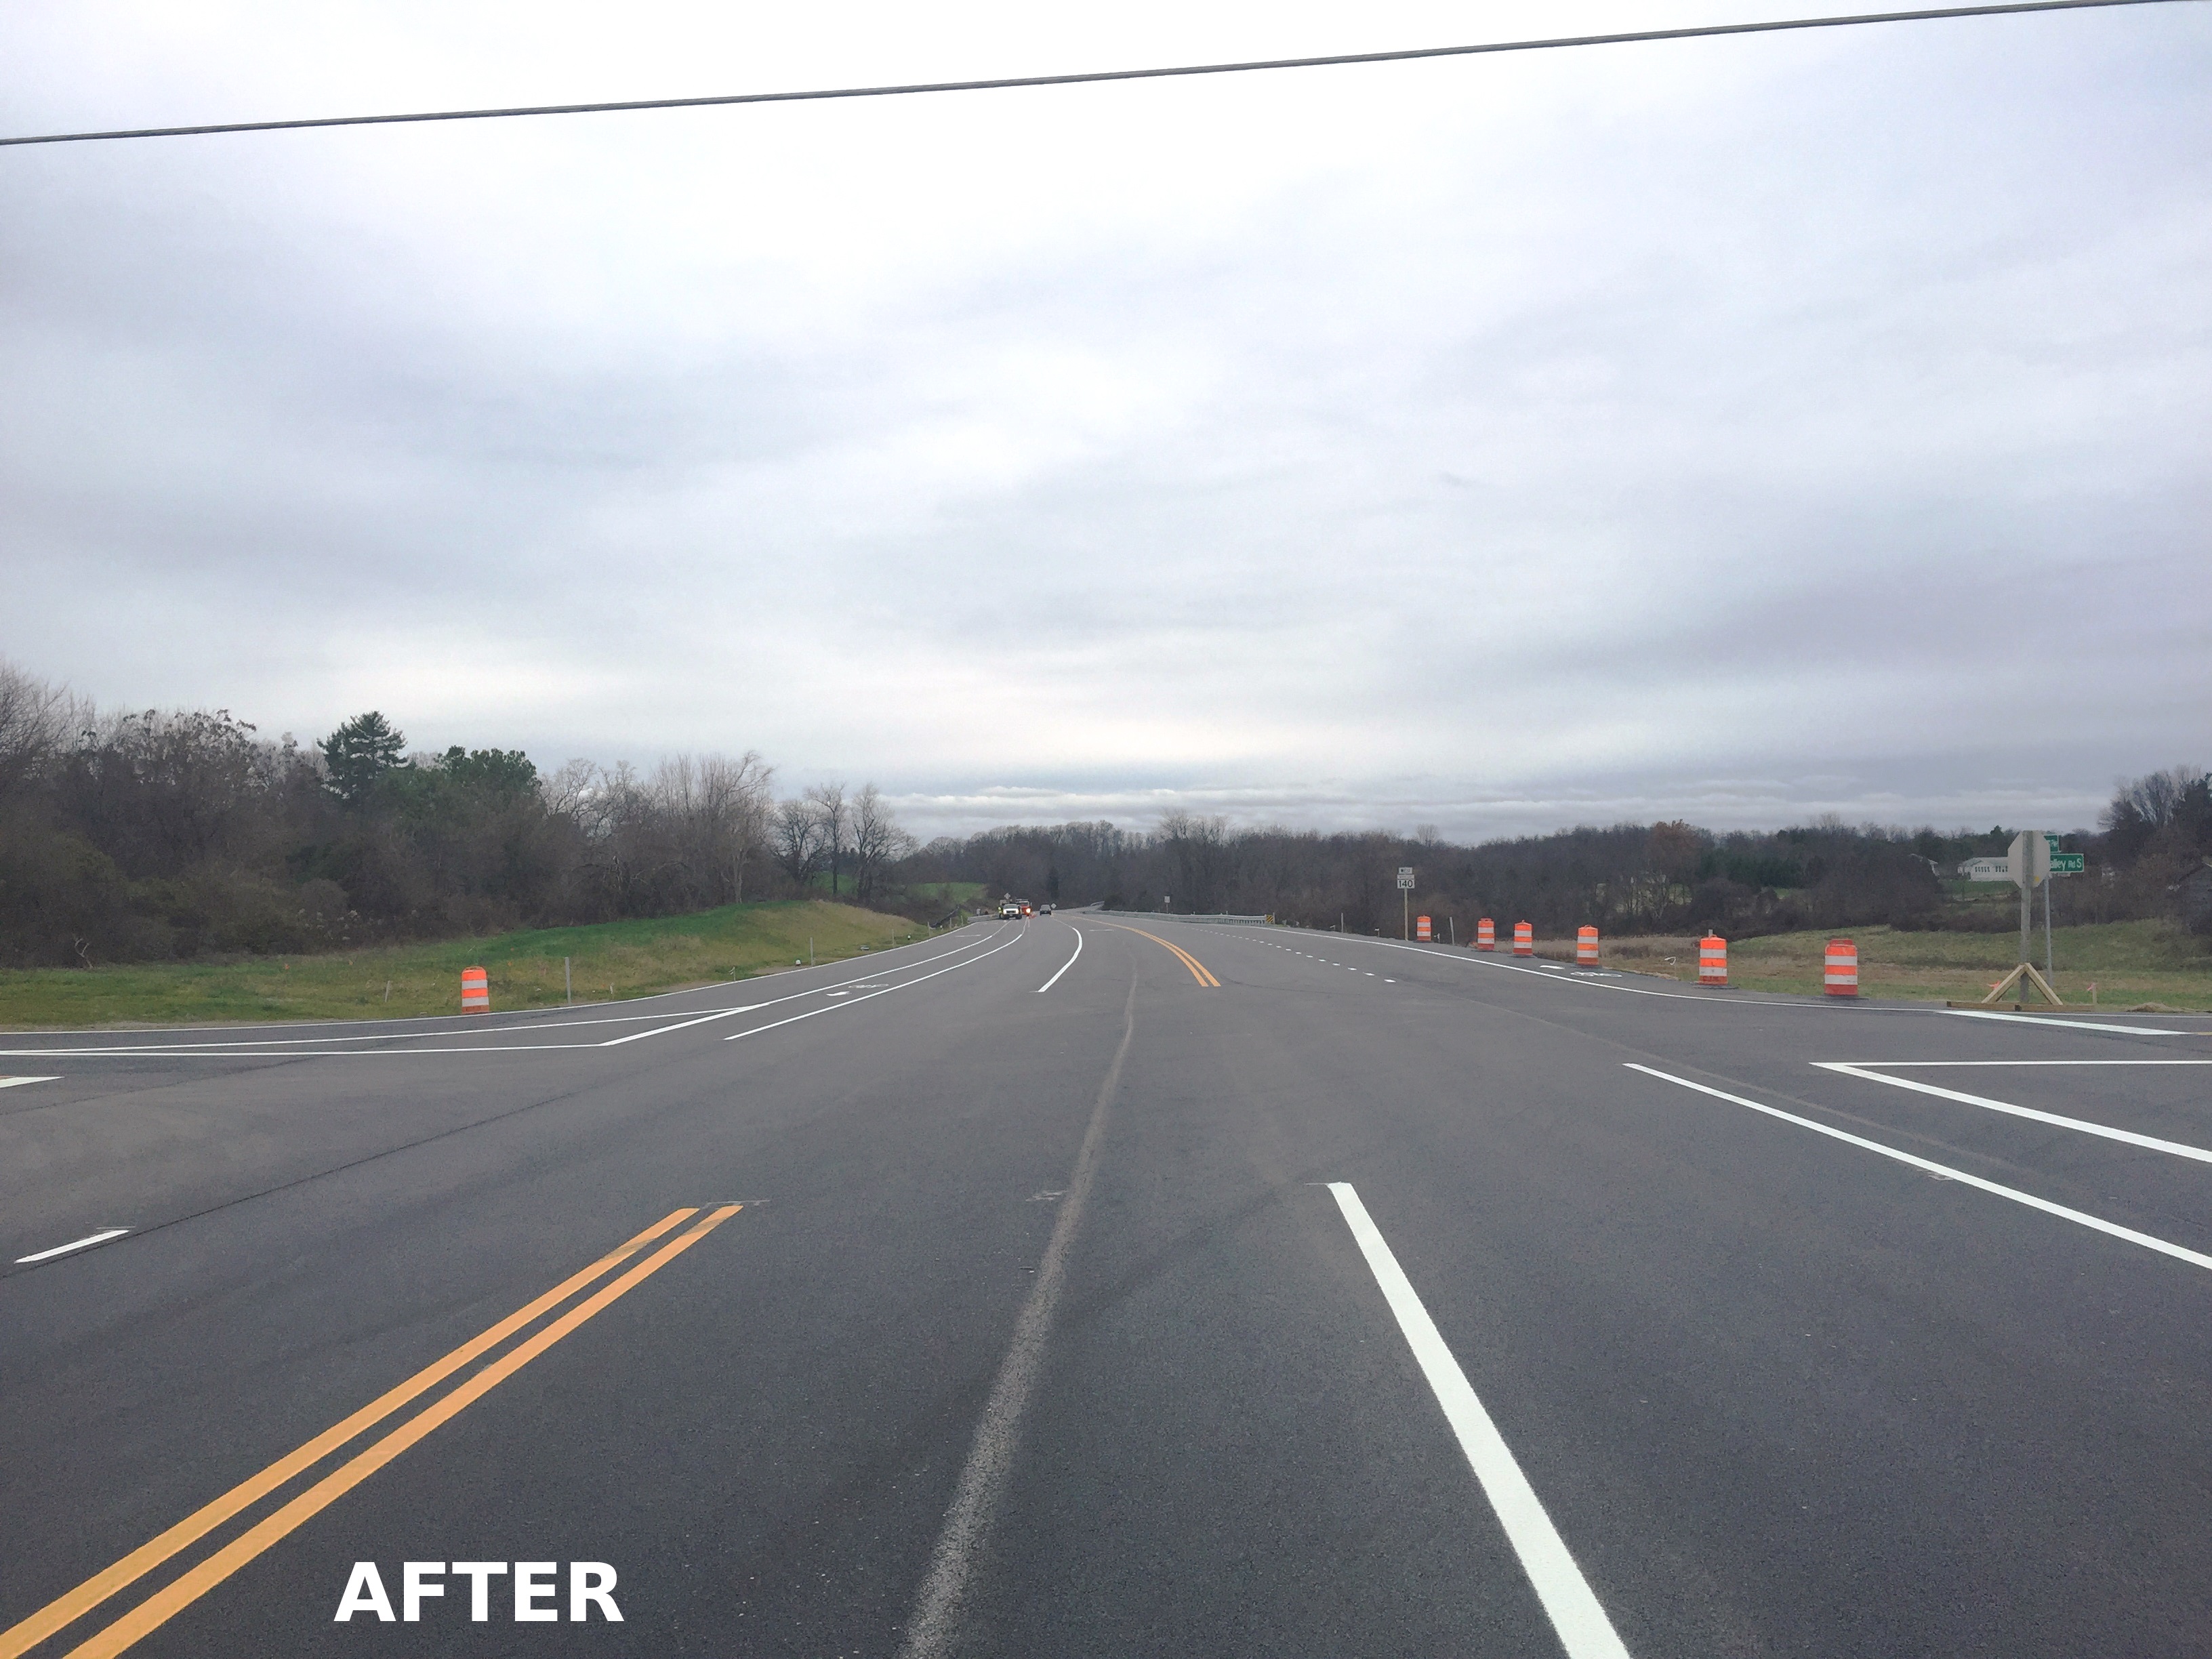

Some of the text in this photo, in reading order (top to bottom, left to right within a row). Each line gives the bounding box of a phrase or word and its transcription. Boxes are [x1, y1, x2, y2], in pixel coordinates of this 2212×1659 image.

[2050, 859, 2066, 871] alley
[2076, 858, 2082, 868] S
[1399, 880, 1413, 888] 140
